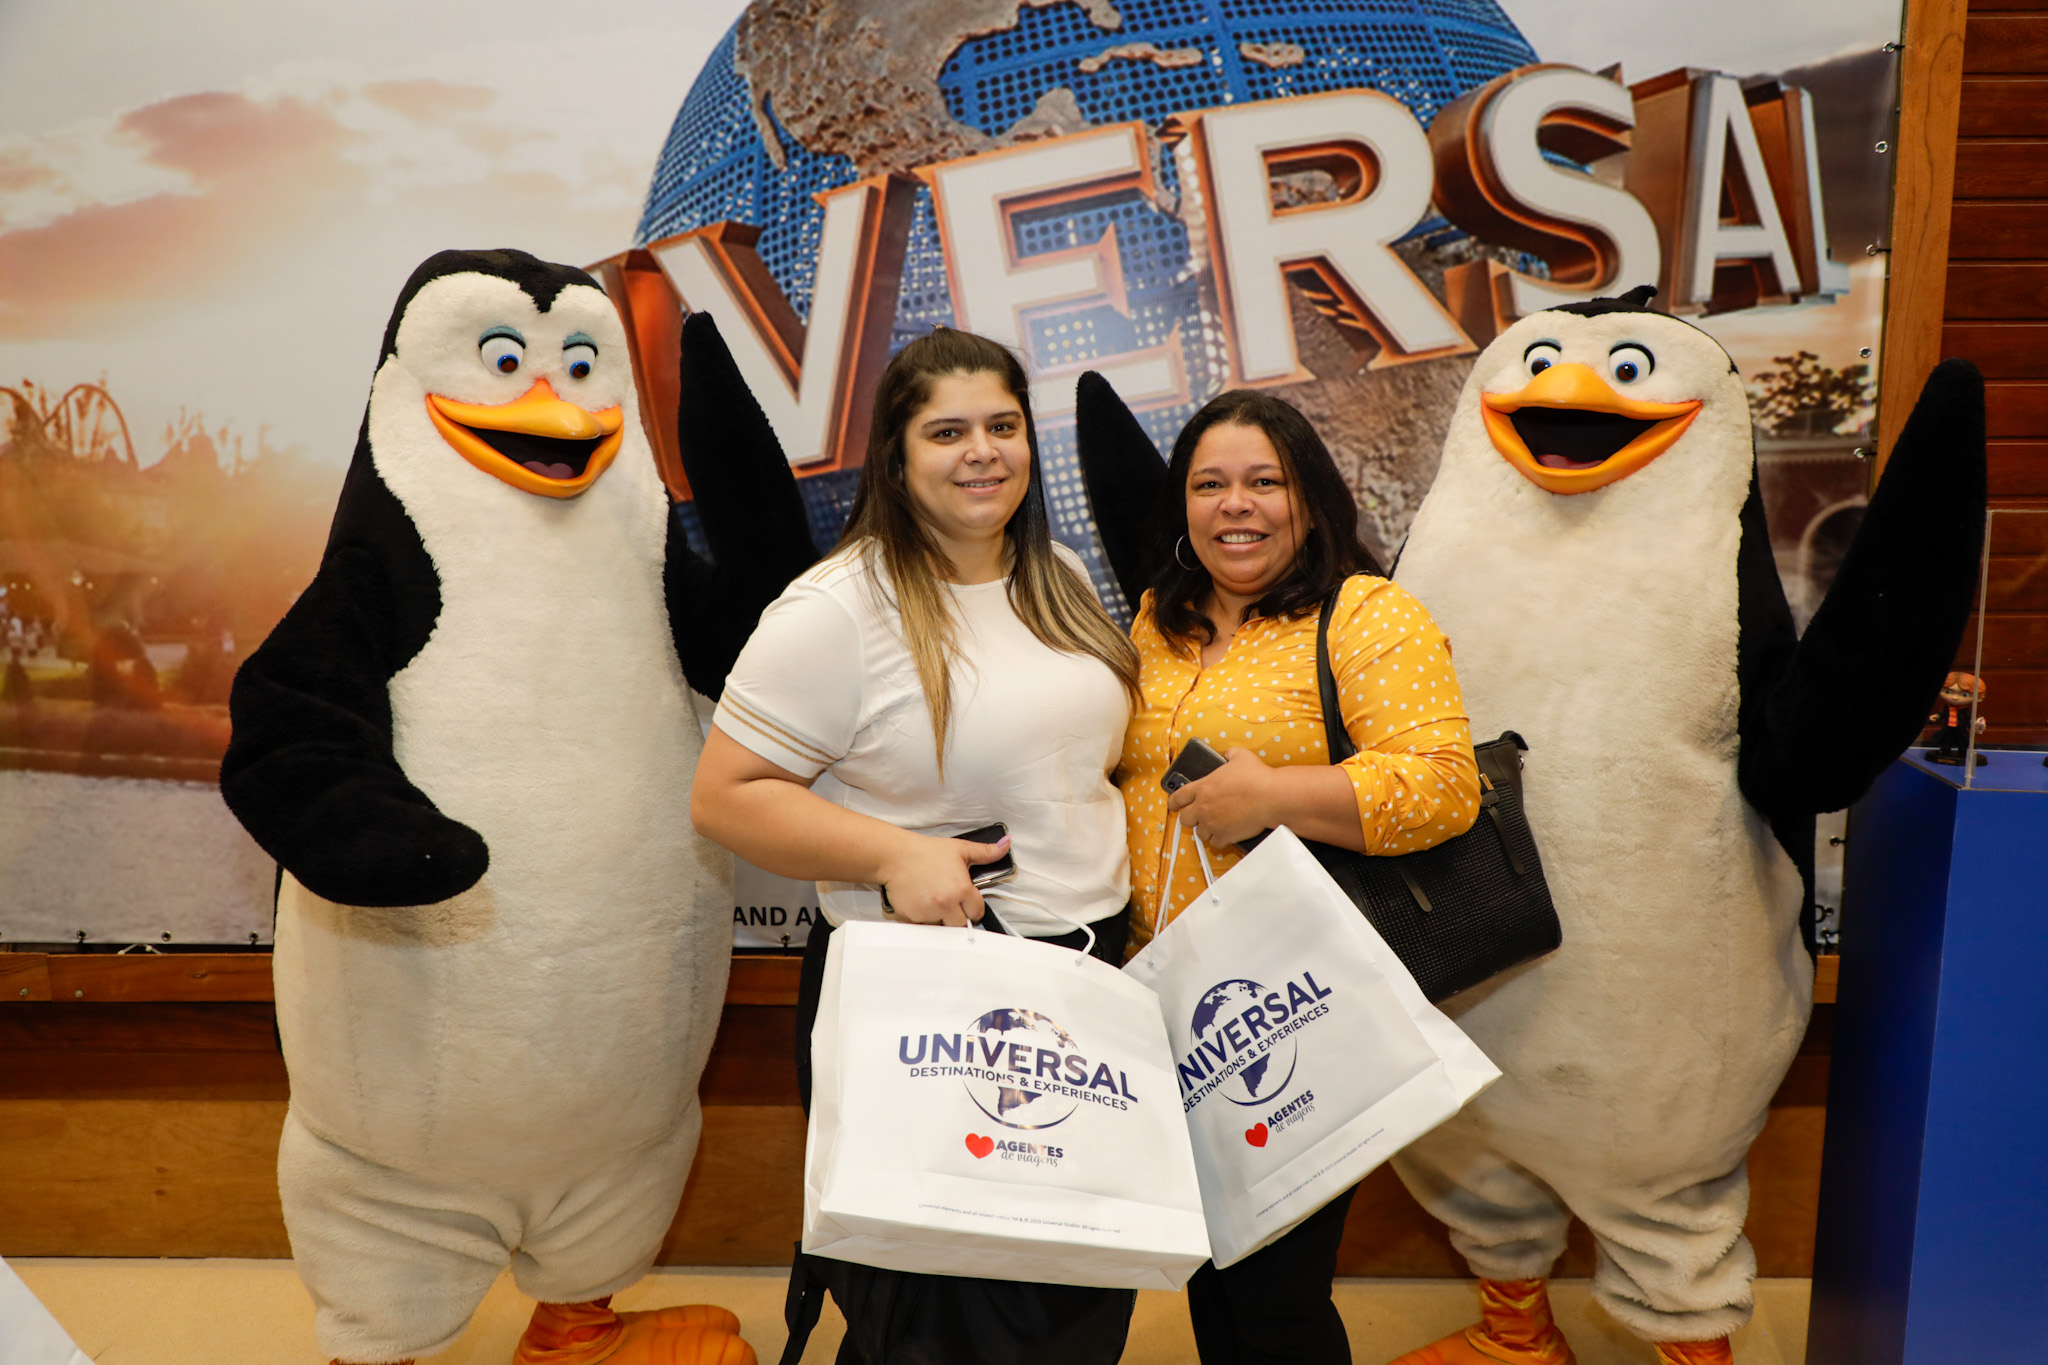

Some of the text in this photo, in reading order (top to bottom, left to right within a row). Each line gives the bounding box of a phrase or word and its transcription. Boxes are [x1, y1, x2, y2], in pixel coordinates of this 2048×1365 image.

[734, 906, 787, 926] AND
[1177, 971, 1332, 1099] NIVERSAL
[1247, 1048, 1258, 1059] &
[1257, 1003, 1329, 1052] EXPERIENCES
[899, 1033, 1138, 1104] UNIVERSAL
[910, 1066, 1128, 1111] DESTINATIONS & EXPERIENCES
[1267, 1090, 1314, 1128] AGENTES
[1275, 1103, 1315, 1133] de viagens
[996, 1139, 1063, 1158] AGENTES
[1001, 1149, 1058, 1167] de viagens
